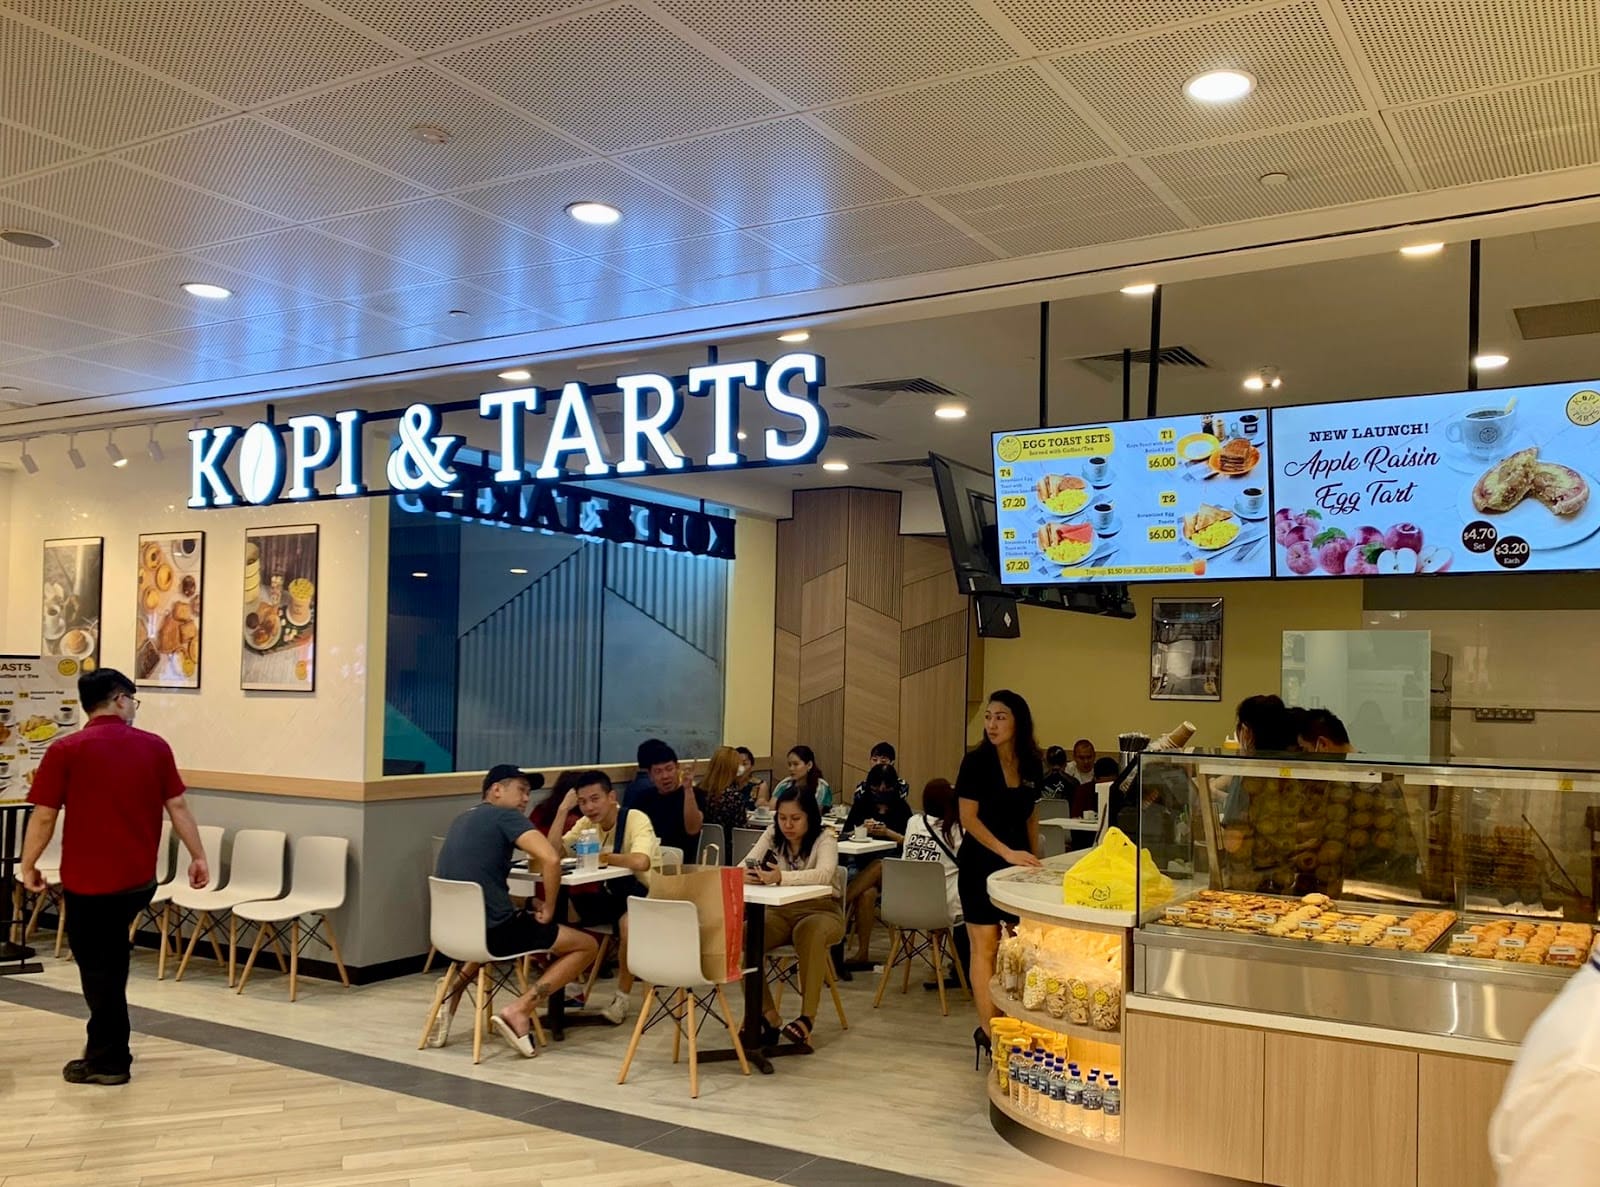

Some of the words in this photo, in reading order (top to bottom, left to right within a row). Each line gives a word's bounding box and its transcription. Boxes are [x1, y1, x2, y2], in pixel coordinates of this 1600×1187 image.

[188, 409, 367, 507] KOPI
[386, 403, 466, 492] &
[480, 353, 828, 482] TARTS
[1160, 430, 1173, 439] T1
[1309, 429, 1348, 442] NEW
[1352, 423, 1429, 439] LAUNCH!
[1022, 439, 1046, 449] EGG
[1047, 435, 1084, 447] TOAST
[1085, 433, 1111, 444] SETS
[1149, 457, 1176, 468] $6.00
[1284, 449, 1361, 480] Apple
[1364, 445, 1441, 473] Raisin
[1000, 469, 1011, 477] T4
[1161, 495, 1176, 503] T2
[1315, 482, 1361, 515] Egg
[1366, 479, 1419, 507] Tart
[1002, 498, 1026, 508] $7.20
[1004, 531, 1015, 539] T5
[1149, 529, 1176, 540] $6.00
[1463, 528, 1496, 540] $4.70
[1473, 542, 1486, 551] Set
[1495, 543, 1529, 555] $3.20
[1006, 561, 1030, 571] $7.20
[0, 663, 32, 672] ASTS
